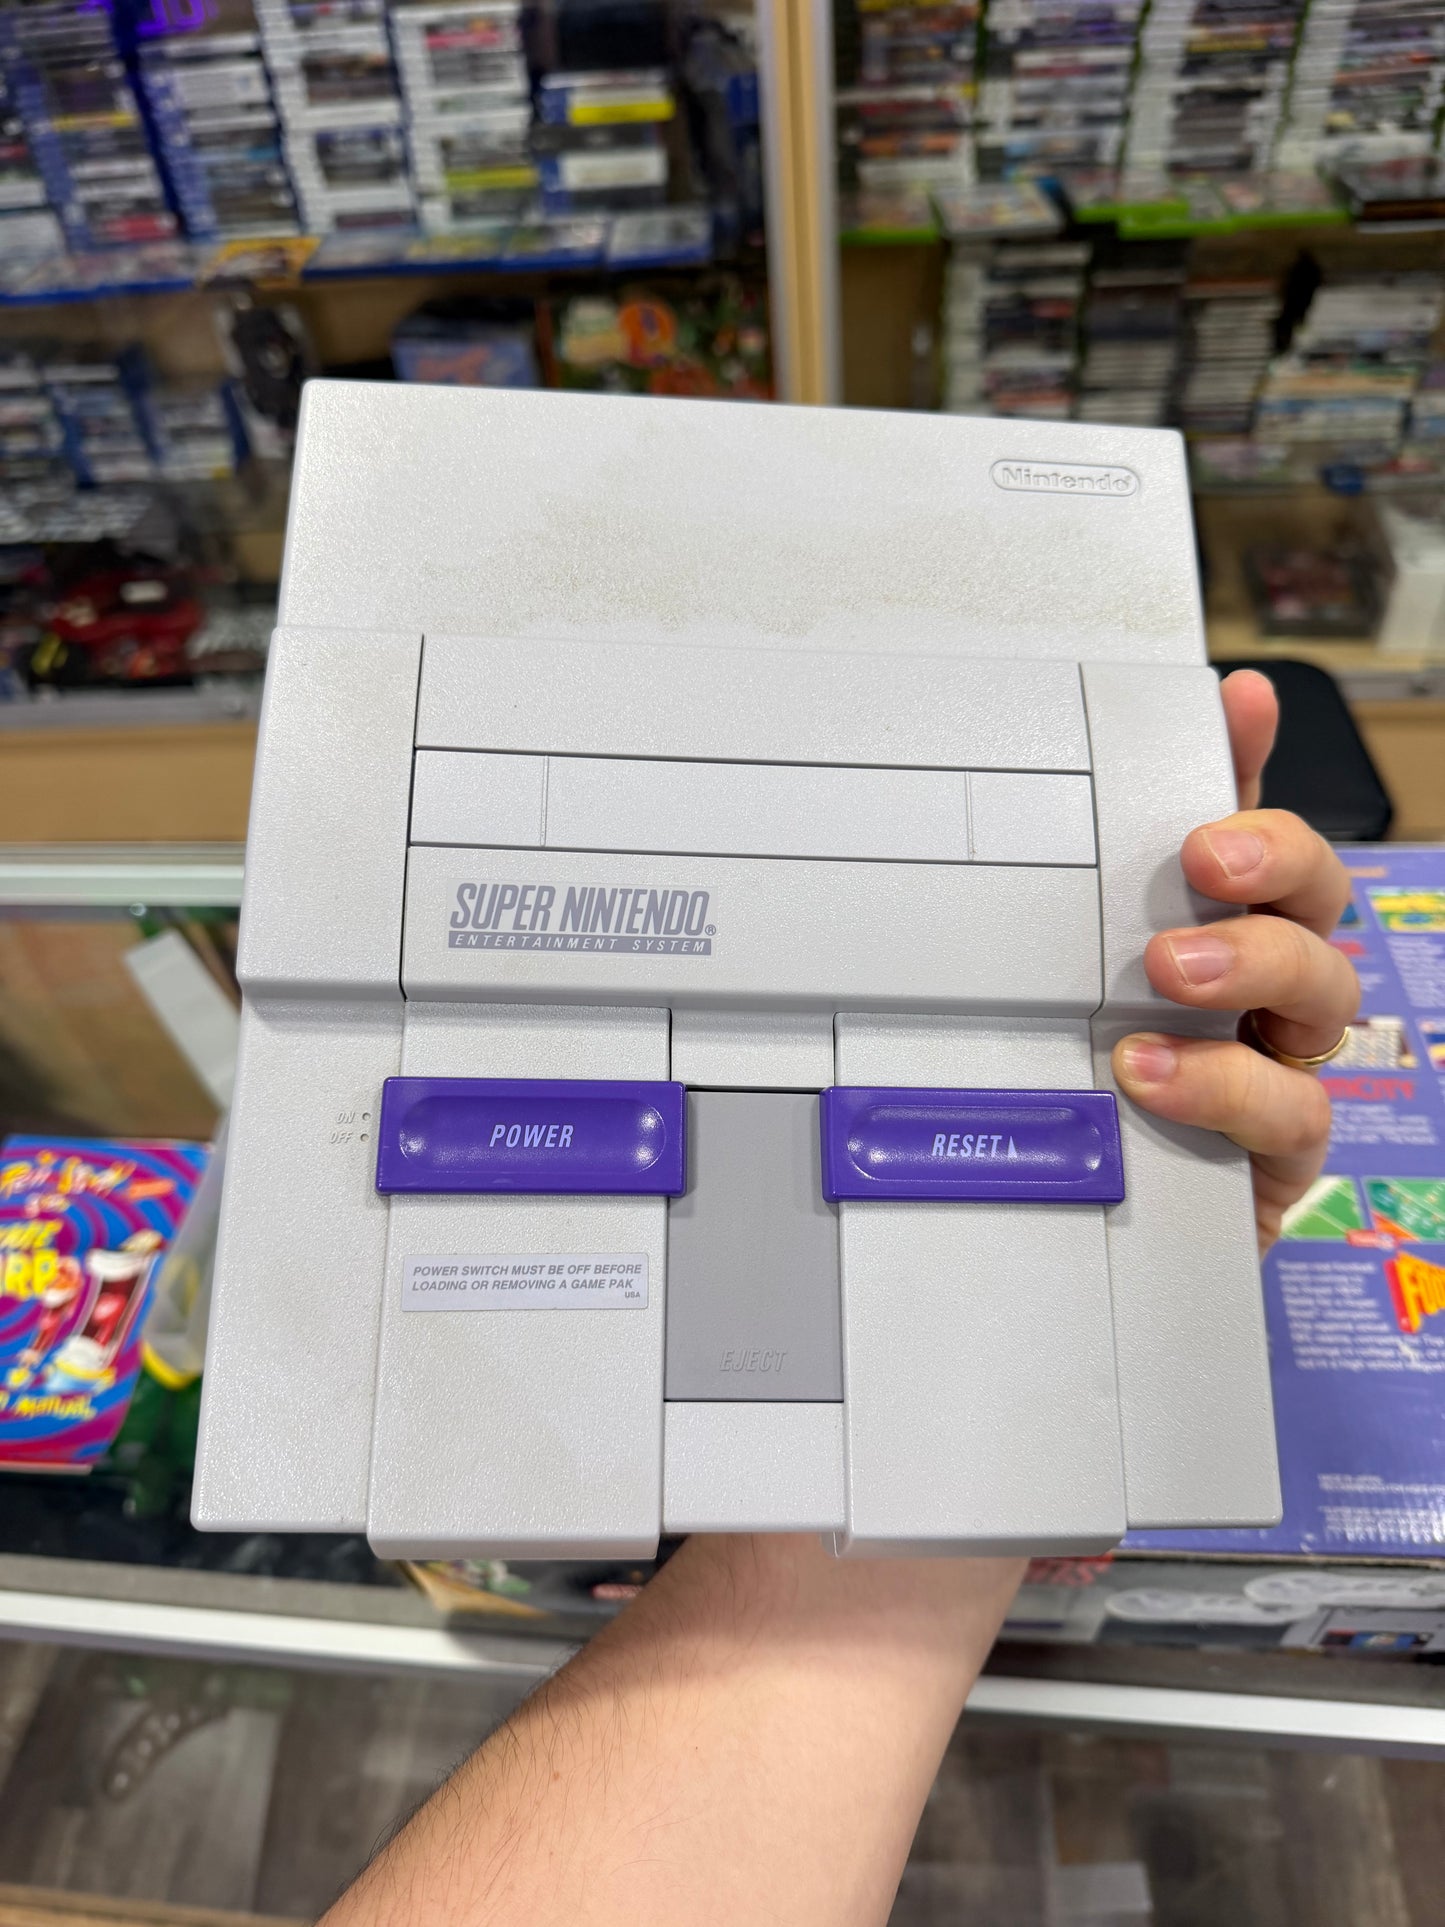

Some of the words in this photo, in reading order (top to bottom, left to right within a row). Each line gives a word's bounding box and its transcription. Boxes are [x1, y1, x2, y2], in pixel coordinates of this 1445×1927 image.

[449, 882, 556, 931] SUPER
[454, 933, 619, 951] ENTERTAINMENT
[631, 939, 706, 953] SYSTEM
[335, 1111, 356, 1125] ON
[329, 1131, 354, 1145] OFF
[488, 1123, 575, 1149] POWER
[930, 1133, 1004, 1158] RESET
[412, 1265, 459, 1277] POWER
[460, 1264, 510, 1276] SWITCH
[510, 1264, 547, 1276] MUST
[547, 1264, 565, 1275] BE
[566, 1264, 592, 1275] OFF
[592, 1263, 643, 1275] BEFORE
[411, 1280, 468, 1292] LOADING
[470, 1279, 489, 1291] OR
[491, 1279, 556, 1290] REMOVING
[558, 1279, 568, 1290] A
[570, 1278, 606, 1290] GAME
[607, 1278, 634, 1290] PAK
[624, 1291, 642, 1299] USA
[719, 1348, 788, 1373] EJECT
